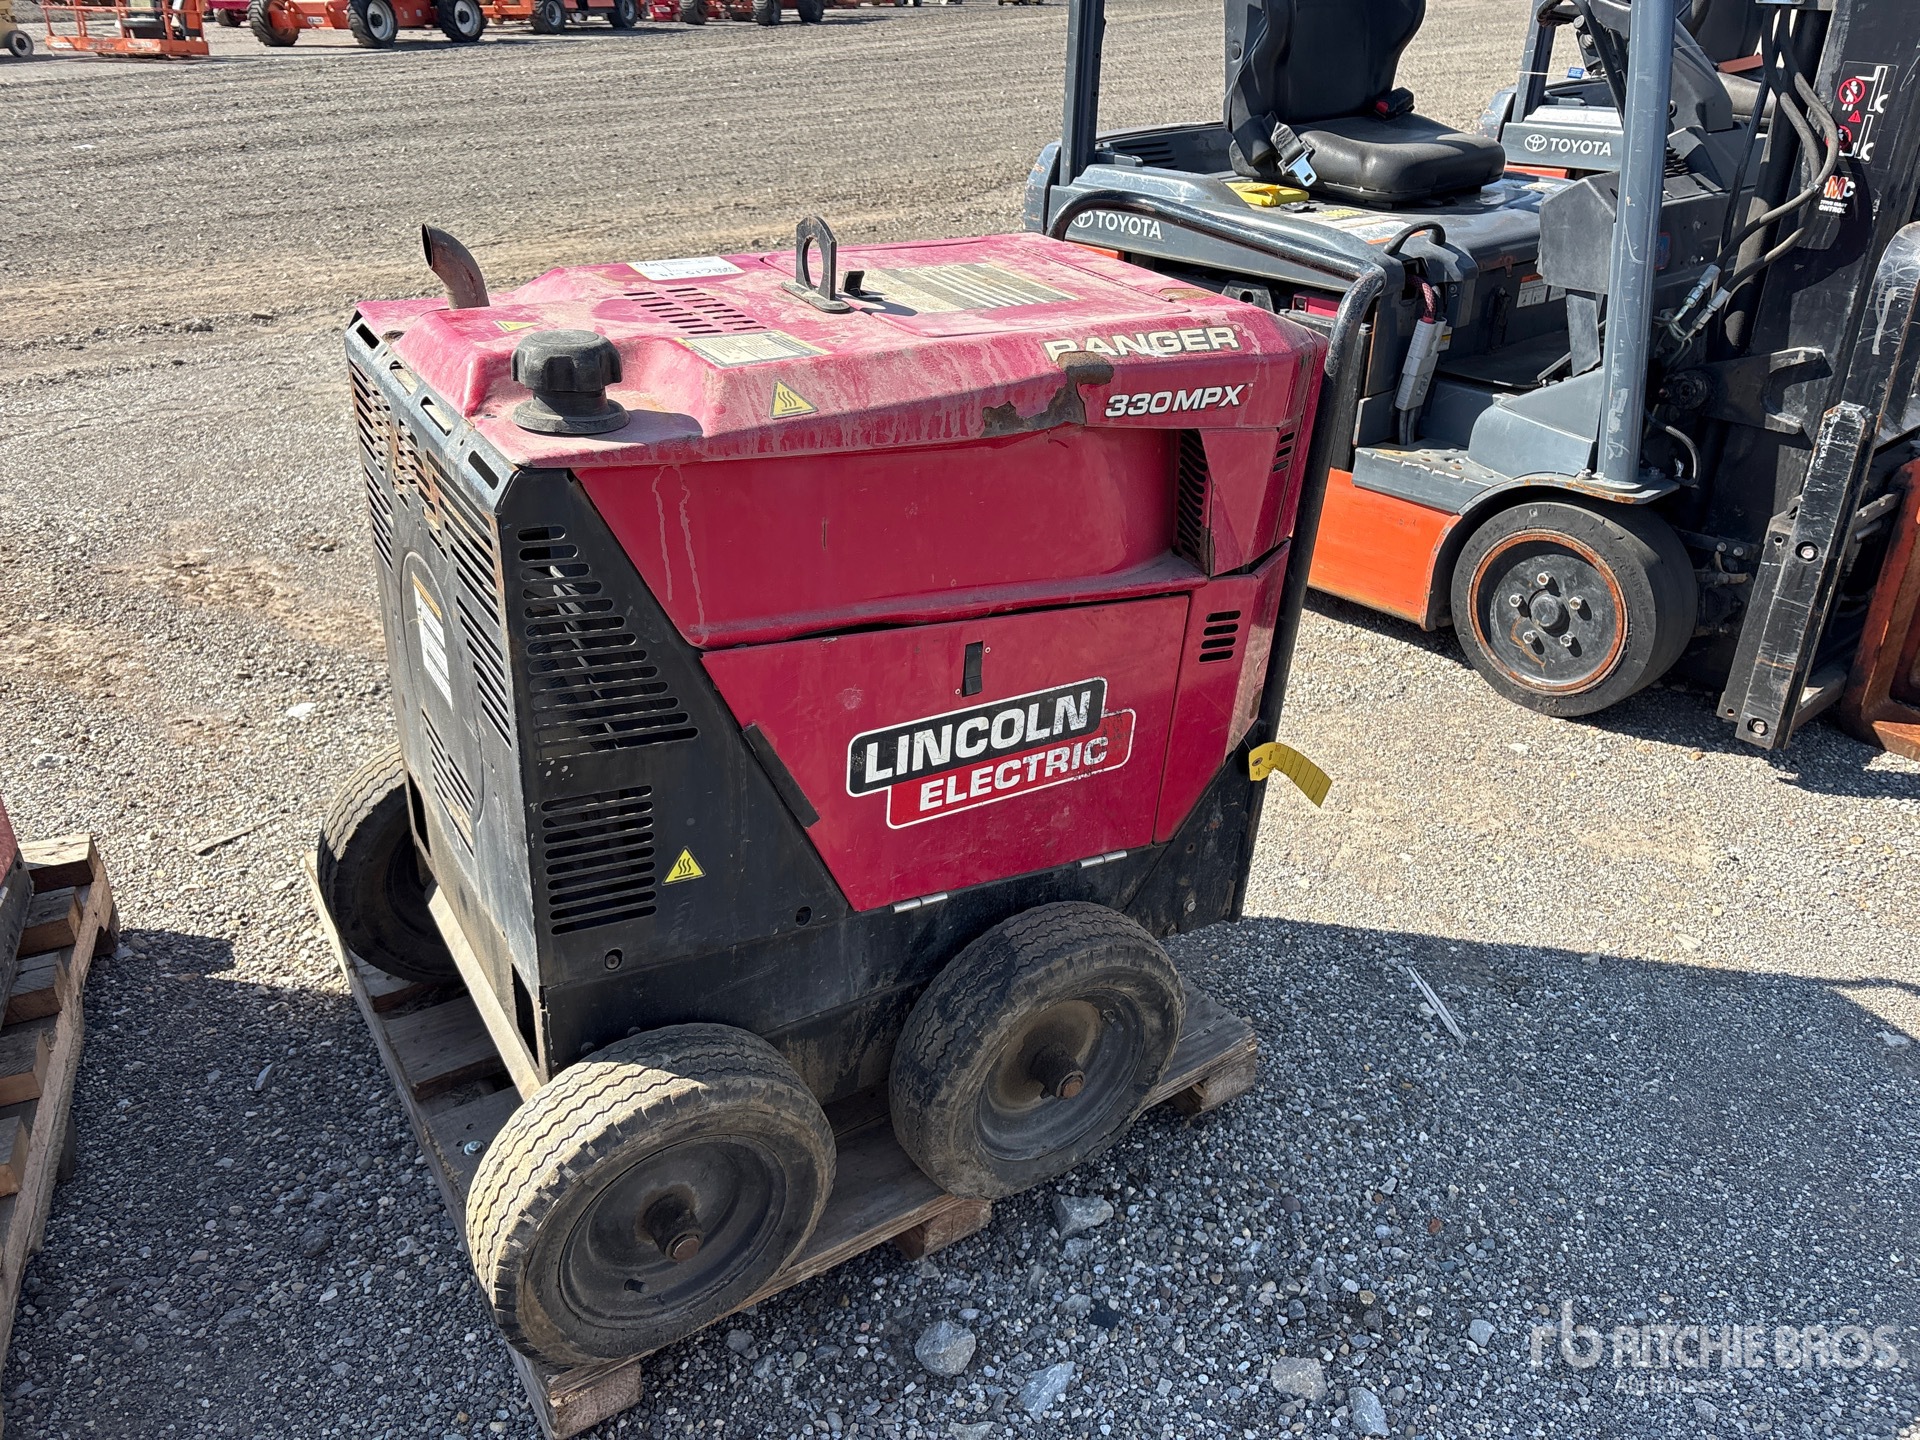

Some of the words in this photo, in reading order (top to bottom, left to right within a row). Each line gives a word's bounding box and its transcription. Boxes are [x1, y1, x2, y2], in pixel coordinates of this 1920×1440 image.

[1550, 138, 1612, 157] TOYOTA
[1818, 204, 1846, 214] ONTROL
[1096, 210, 1162, 240] TOYOTA
[865, 690, 1091, 784] LINCOLN
[919, 736, 1109, 812] ELECTRIC
